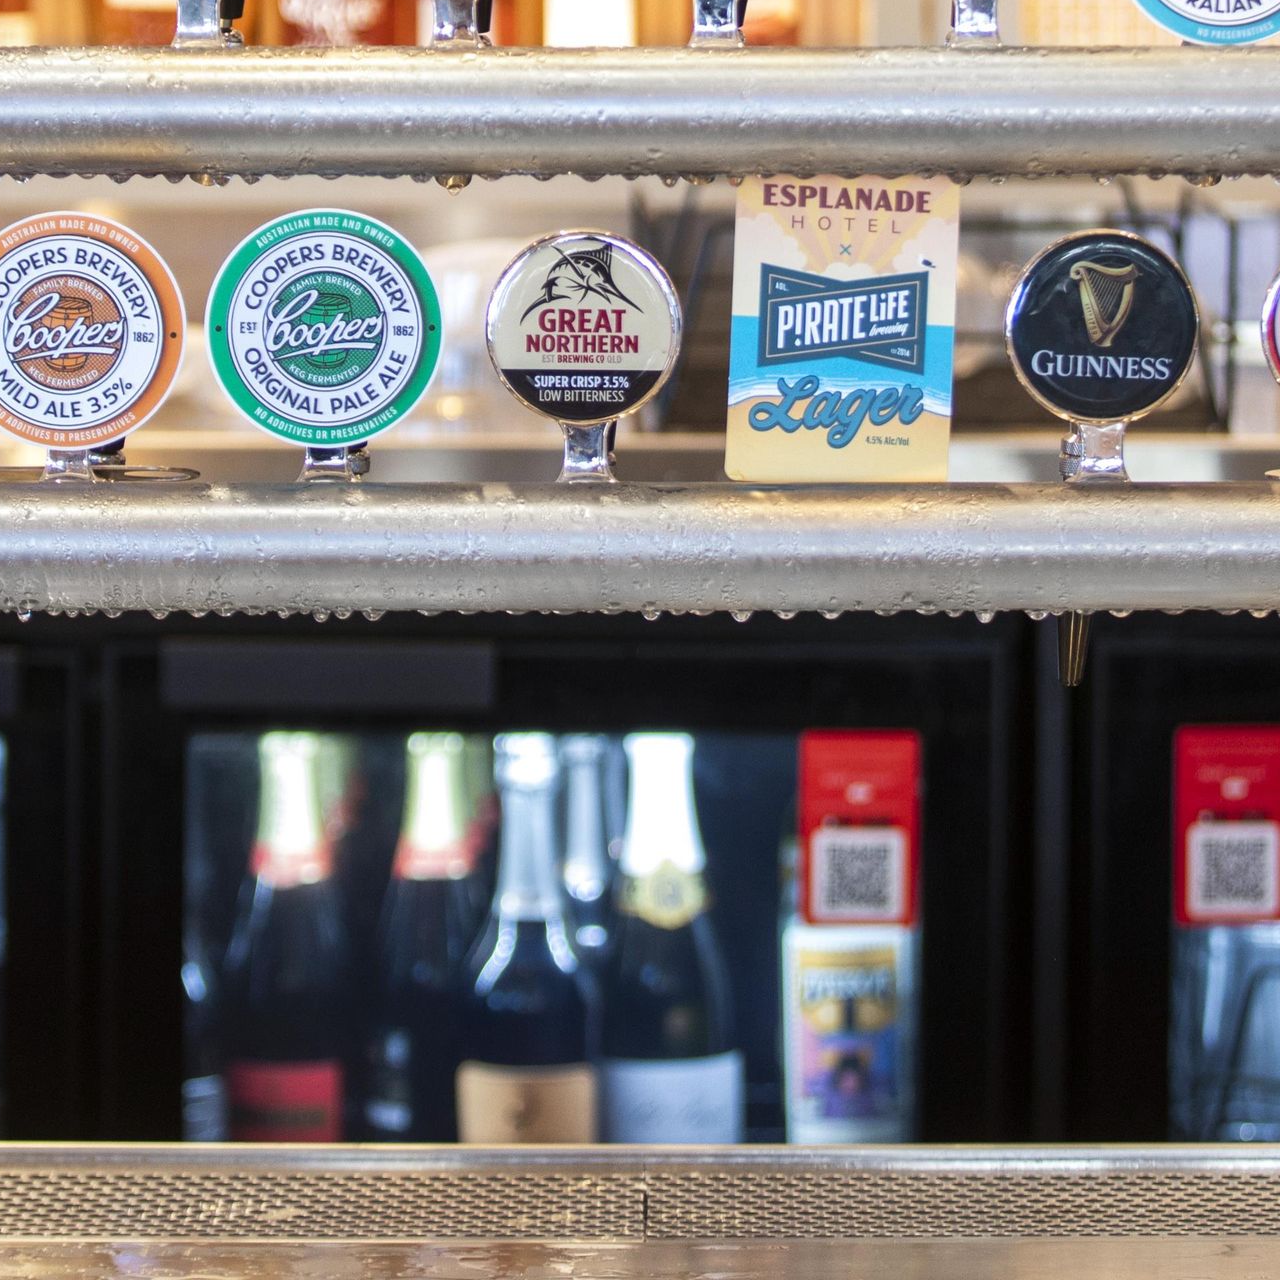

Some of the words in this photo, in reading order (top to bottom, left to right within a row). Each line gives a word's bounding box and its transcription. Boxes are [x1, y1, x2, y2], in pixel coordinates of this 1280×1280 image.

[763, 184, 931, 213] ESPLANADE
[1, 221, 56, 249] AUSTRALIAN
[59, 219, 85, 230] MADE
[88, 221, 106, 235] AND
[109, 229, 140, 253] OWNED
[256, 219, 310, 248] AUSTRALIAN
[314, 217, 339, 227] MADE
[342, 218, 360, 231] AND
[363, 225, 395, 248] OWNED
[791, 215, 901, 234] HOTEL
[32, 279, 65, 296] FAMILY
[68, 280, 103, 301] BREWED
[75, 248, 150, 321] BREWERY
[245, 244, 325, 310] COOPERS
[332, 244, 410, 315] BREWERY
[291, 276, 322, 293] FAMILY
[325, 275, 362, 296] BREWED
[6, 292, 126, 358] Coopers
[240, 322, 257, 333] EST
[266, 289, 386, 355] Coopers
[393, 325, 414, 337] 1862
[538, 308, 626, 333] GREAT
[869, 322, 909, 337] brewing
[133, 331, 154, 343] 1862
[526, 334, 639, 353] NORTHERN
[542, 355, 555, 363] EST
[558, 355, 594, 364] BREWING
[607, 356, 622, 364] QLD
[1031, 349, 1170, 380] GUINNESS
[28, 366, 44, 382] KEG
[47, 370, 99, 387] FERMENTED
[245, 348, 323, 415] ORIGINAL
[330, 383, 379, 415] PALE
[379, 350, 407, 389] ALE
[289, 364, 305, 378] KEG
[307, 365, 360, 383] FERMENTED
[534, 375, 569, 388] SUPER
[571, 376, 600, 388] CRISP
[603, 376, 629, 388] 3.5%
[44, 401, 82, 418] ALE
[87, 377, 133, 414] 3.5%
[539, 390, 562, 402] LOW
[564, 390, 624, 402] BITTERNESS
[254, 406, 265, 419] NO
[267, 415, 312, 439] ADDITIVES
[316, 430, 327, 439] OR
[330, 406, 397, 439] PRESERVATIVES
[749, 375, 924, 449] Lager
[6, 414, 50, 441] ADDITIVES
[54, 432, 65, 442] OR
[68, 412, 136, 441] PRESERVATIVES
[865, 435, 882, 445] 4.5%
[884, 436, 910, 446] Alc/Vol
